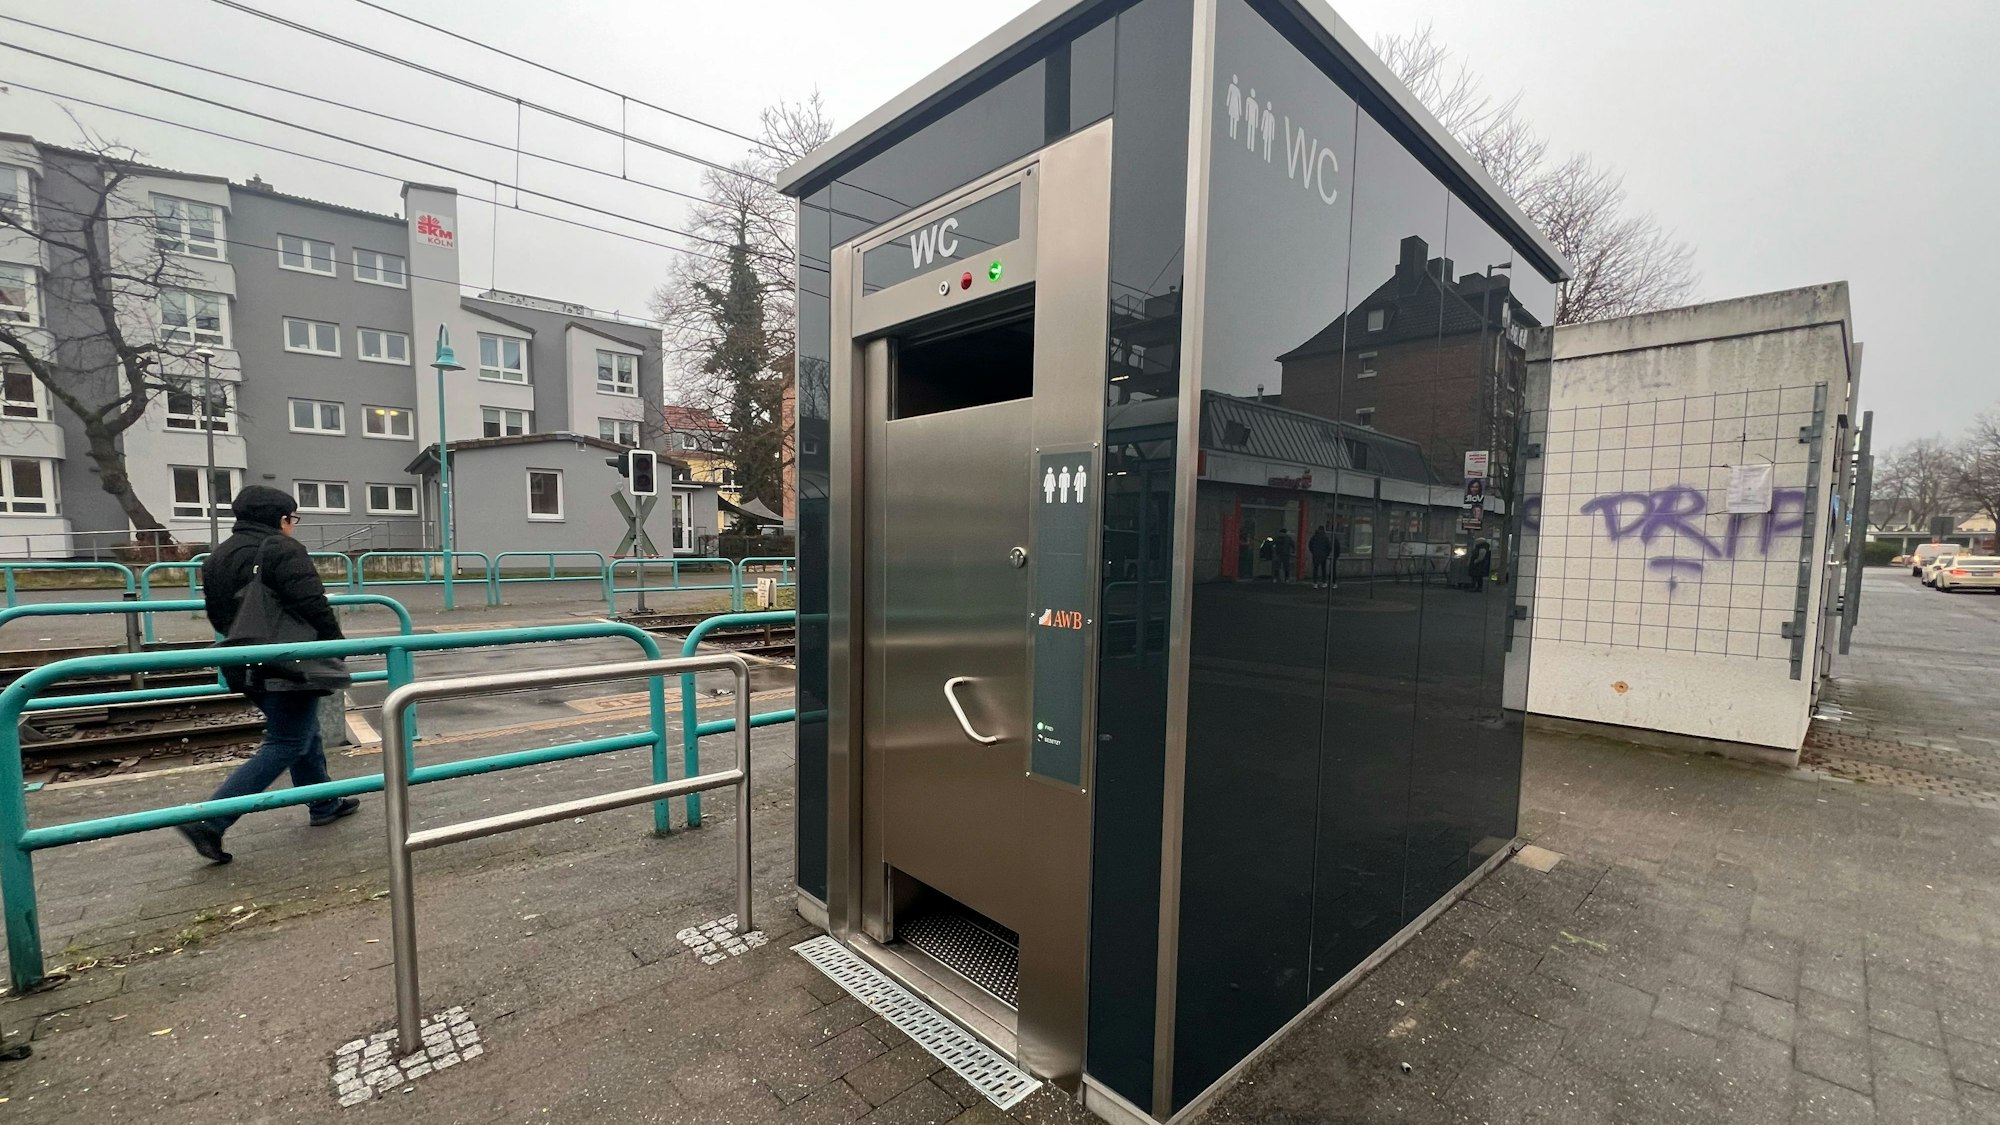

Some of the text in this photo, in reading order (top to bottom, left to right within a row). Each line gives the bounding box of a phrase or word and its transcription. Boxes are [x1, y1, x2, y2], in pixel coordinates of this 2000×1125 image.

[1284, 115, 1339, 206] WC
[417, 225, 453, 240] SKM
[427, 237, 454, 248] KÖLN
[910, 217, 959, 270] WC
[1052, 609, 1083, 630] AWB
